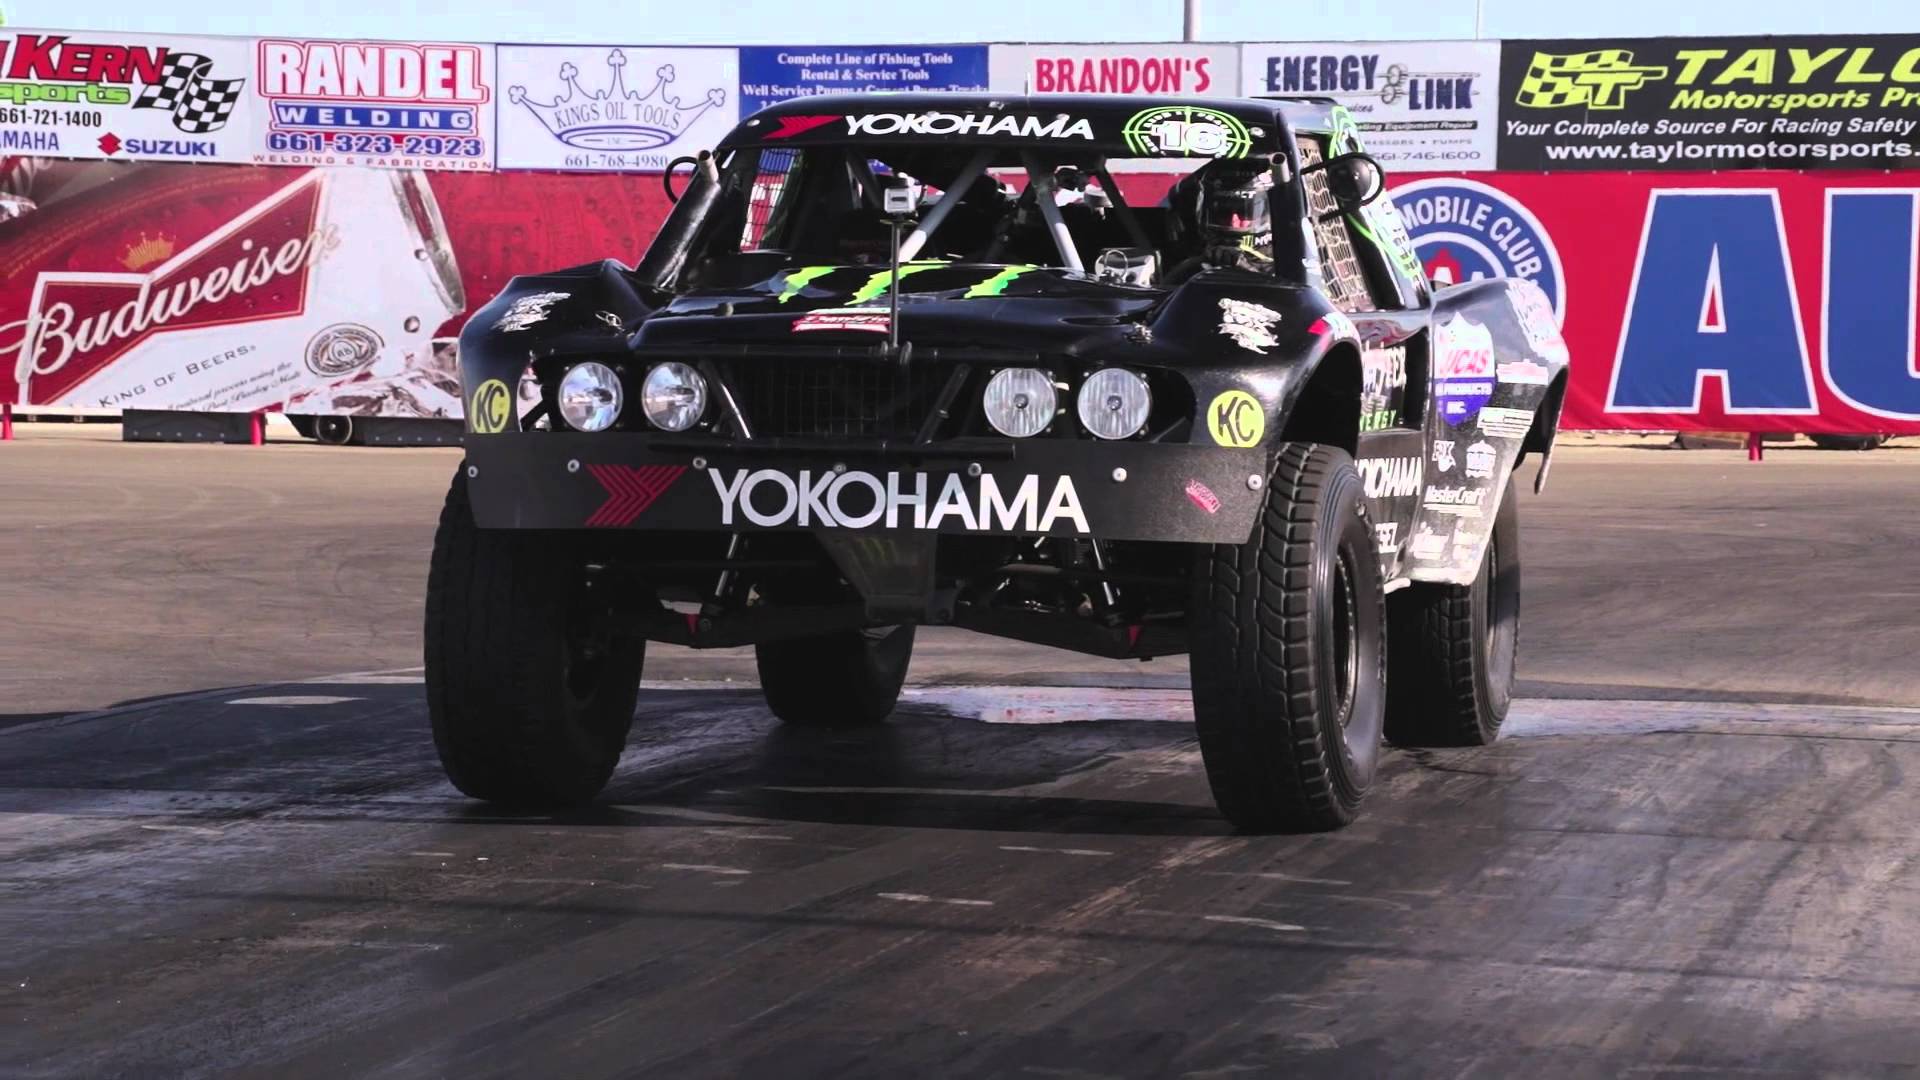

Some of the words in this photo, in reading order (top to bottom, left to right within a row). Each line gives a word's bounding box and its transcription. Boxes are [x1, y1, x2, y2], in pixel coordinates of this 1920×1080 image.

[7, 34, 170, 86] KERN
[263, 43, 486, 101] RANDEL
[778, 53, 832, 66] Complete
[835, 53, 862, 64] Line
[864, 53, 877, 64] of
[879, 53, 920, 67] Fishing
[923, 52, 953, 64] Tools
[1266, 55, 1379, 92] ENERGY
[801, 69, 839, 80] Rental
[842, 69, 853, 80] &
[855, 69, 897, 80] Service
[900, 69, 930, 80] Tools
[1036, 58, 1210, 93] BRANDON'S
[742, 85, 769, 96] Well
[771, 85, 813, 96] Service
[1408, 78, 1473, 110] LINK
[1670, 89, 1872, 115] Motorsports
[1880, 87, 1920, 107] Pr
[278, 105, 473, 129] WELDING
[554, 103, 600, 129] KINGS
[605, 102, 627, 120] OIL
[633, 104, 681, 130] TOOLS
[845, 113, 1095, 140] YOKOHAMA
[1506, 121, 1551, 135] Your
[1554, 120, 1649, 139] Complete
[1654, 119, 1726, 135] Source
[1731, 118, 1767, 133] For
[1771, 118, 1842, 137] Racing
[1847, 117, 1917, 136] Safety
[0, 130, 60, 151] MAHA
[125, 139, 217, 157] SUZUKI
[267, 132, 484, 157] 661-323-2923
[253, 154, 336, 165] WELDING
[366, 158, 493, 169] FABRICATION
[565, 154, 669, 168] 661-768-4980
[1490, 217, 1542, 278] CLUB
[0, 224, 342, 384] Budweiser
[99, 386, 147, 408] KING
[154, 372, 177, 388] OF
[476, 383, 505, 432] KC
[1217, 396, 1255, 445] KC
[708, 468, 1090, 533] YOKOHAMA
